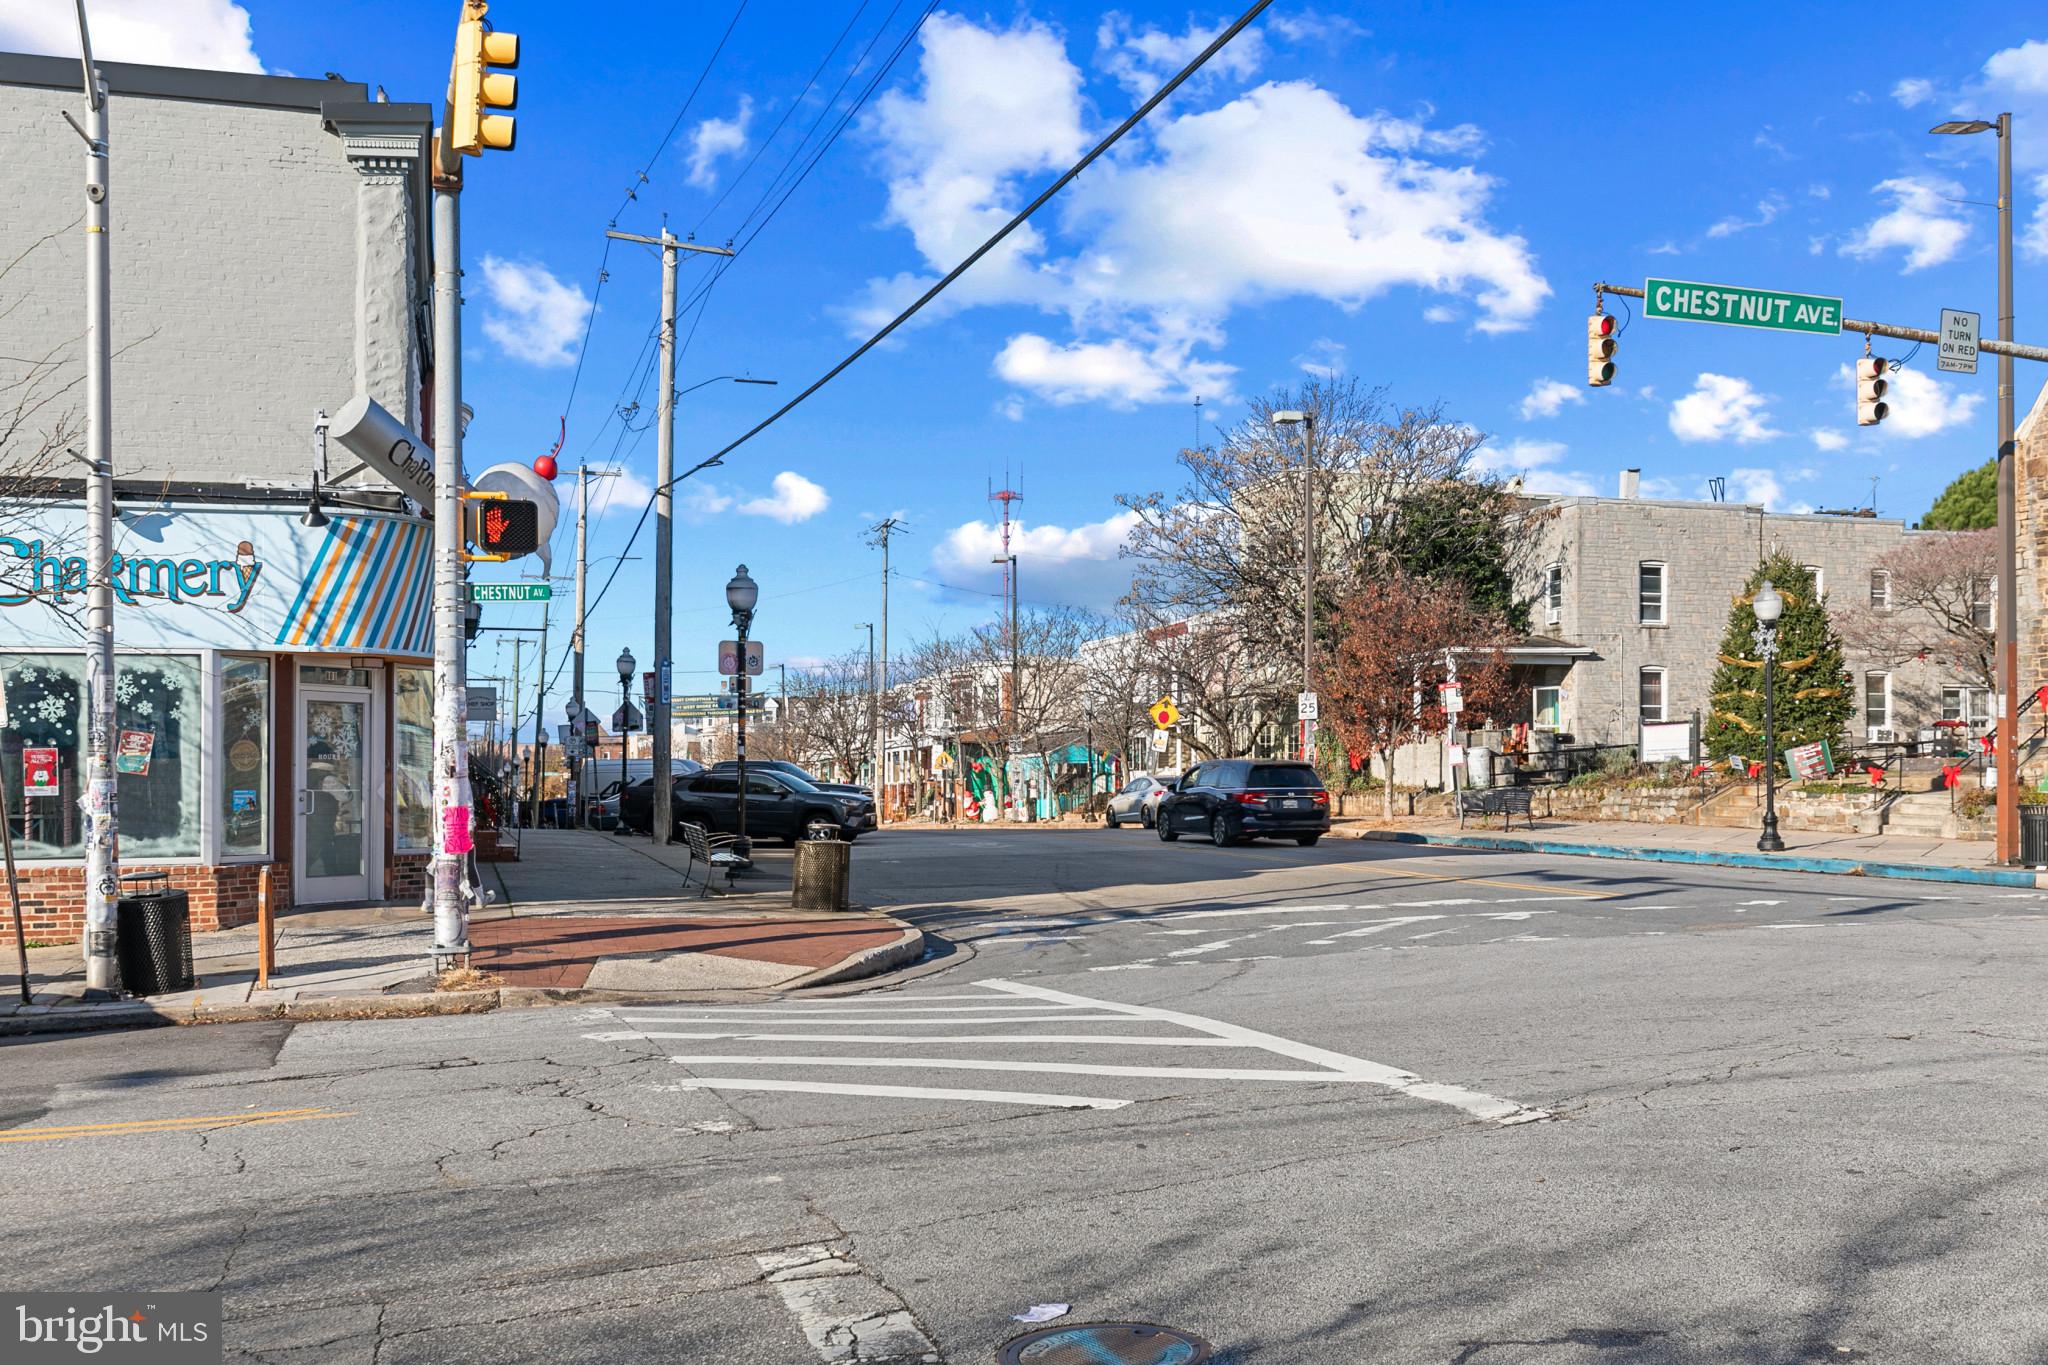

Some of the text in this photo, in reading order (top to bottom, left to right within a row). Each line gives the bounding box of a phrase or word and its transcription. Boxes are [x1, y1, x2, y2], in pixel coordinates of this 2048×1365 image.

[1656, 286, 1838, 327] CHESTNUT AVE.
[1953, 316, 1968, 327] NO
[1948, 329, 1971, 342] TURN
[1942, 342, 1976, 356] ON RED
[1940, 360, 1974, 370] 7AM-7PM
[474, 586, 545, 600] CHESTNUT AV.
[1301, 702, 1316, 713] 25
